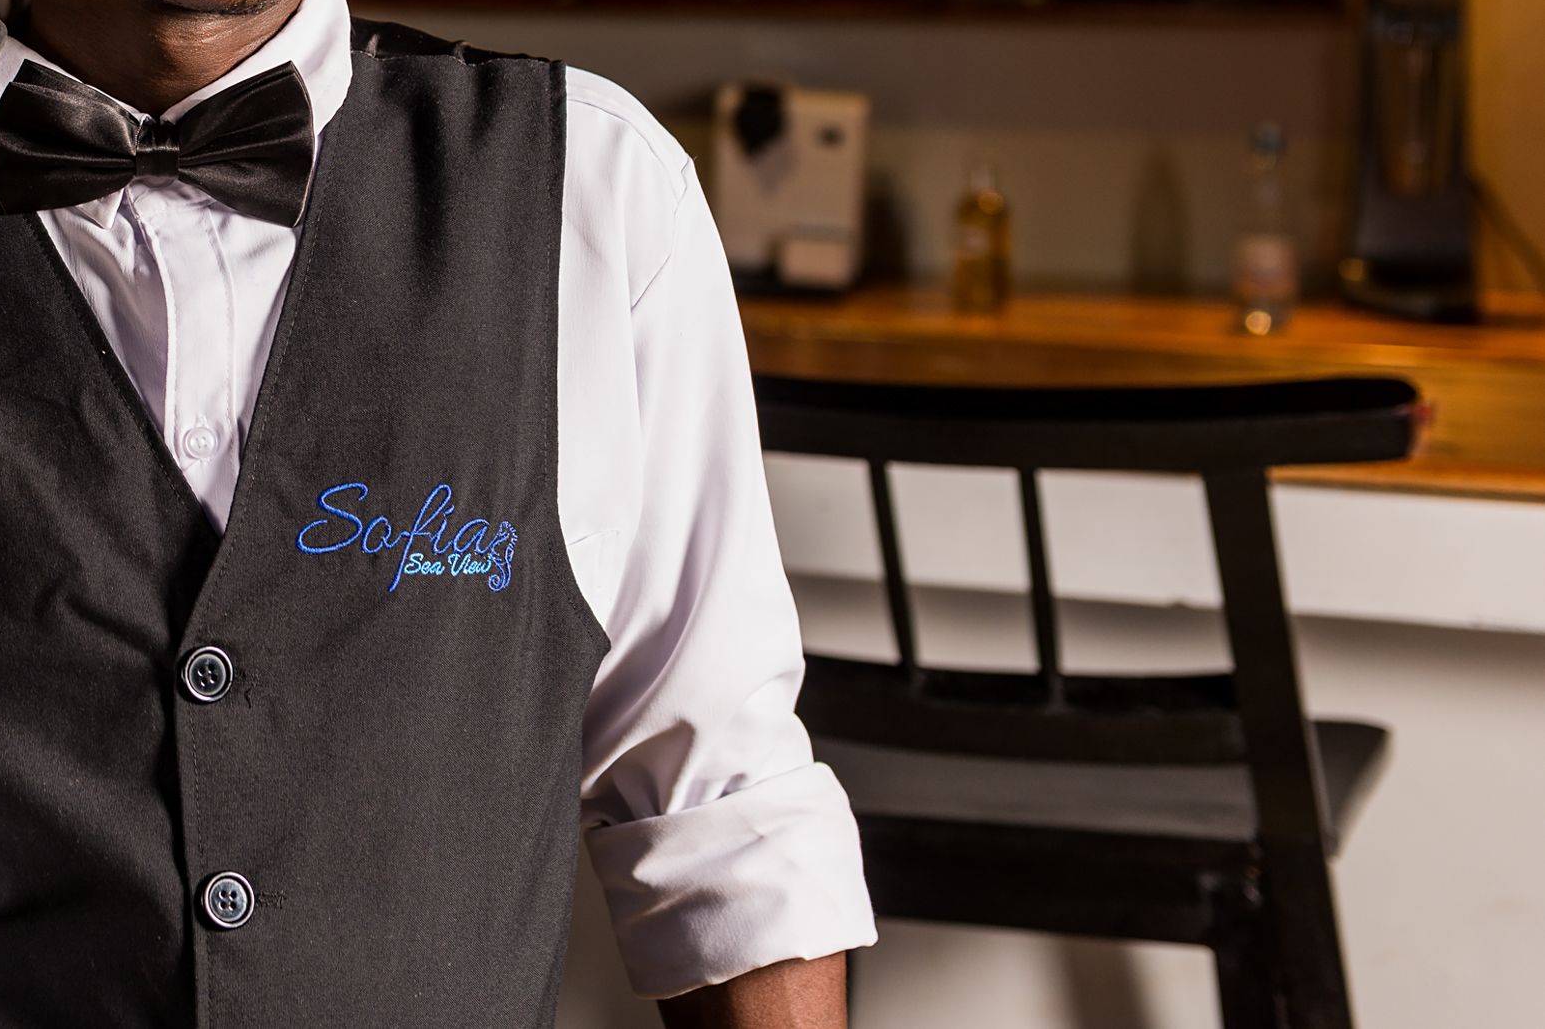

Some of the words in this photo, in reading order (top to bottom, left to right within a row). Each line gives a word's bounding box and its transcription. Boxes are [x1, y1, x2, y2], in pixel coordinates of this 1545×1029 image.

[295, 482, 497, 592] Sofia
[405, 553, 445, 575] Sea
[447, 553, 492, 576] View
